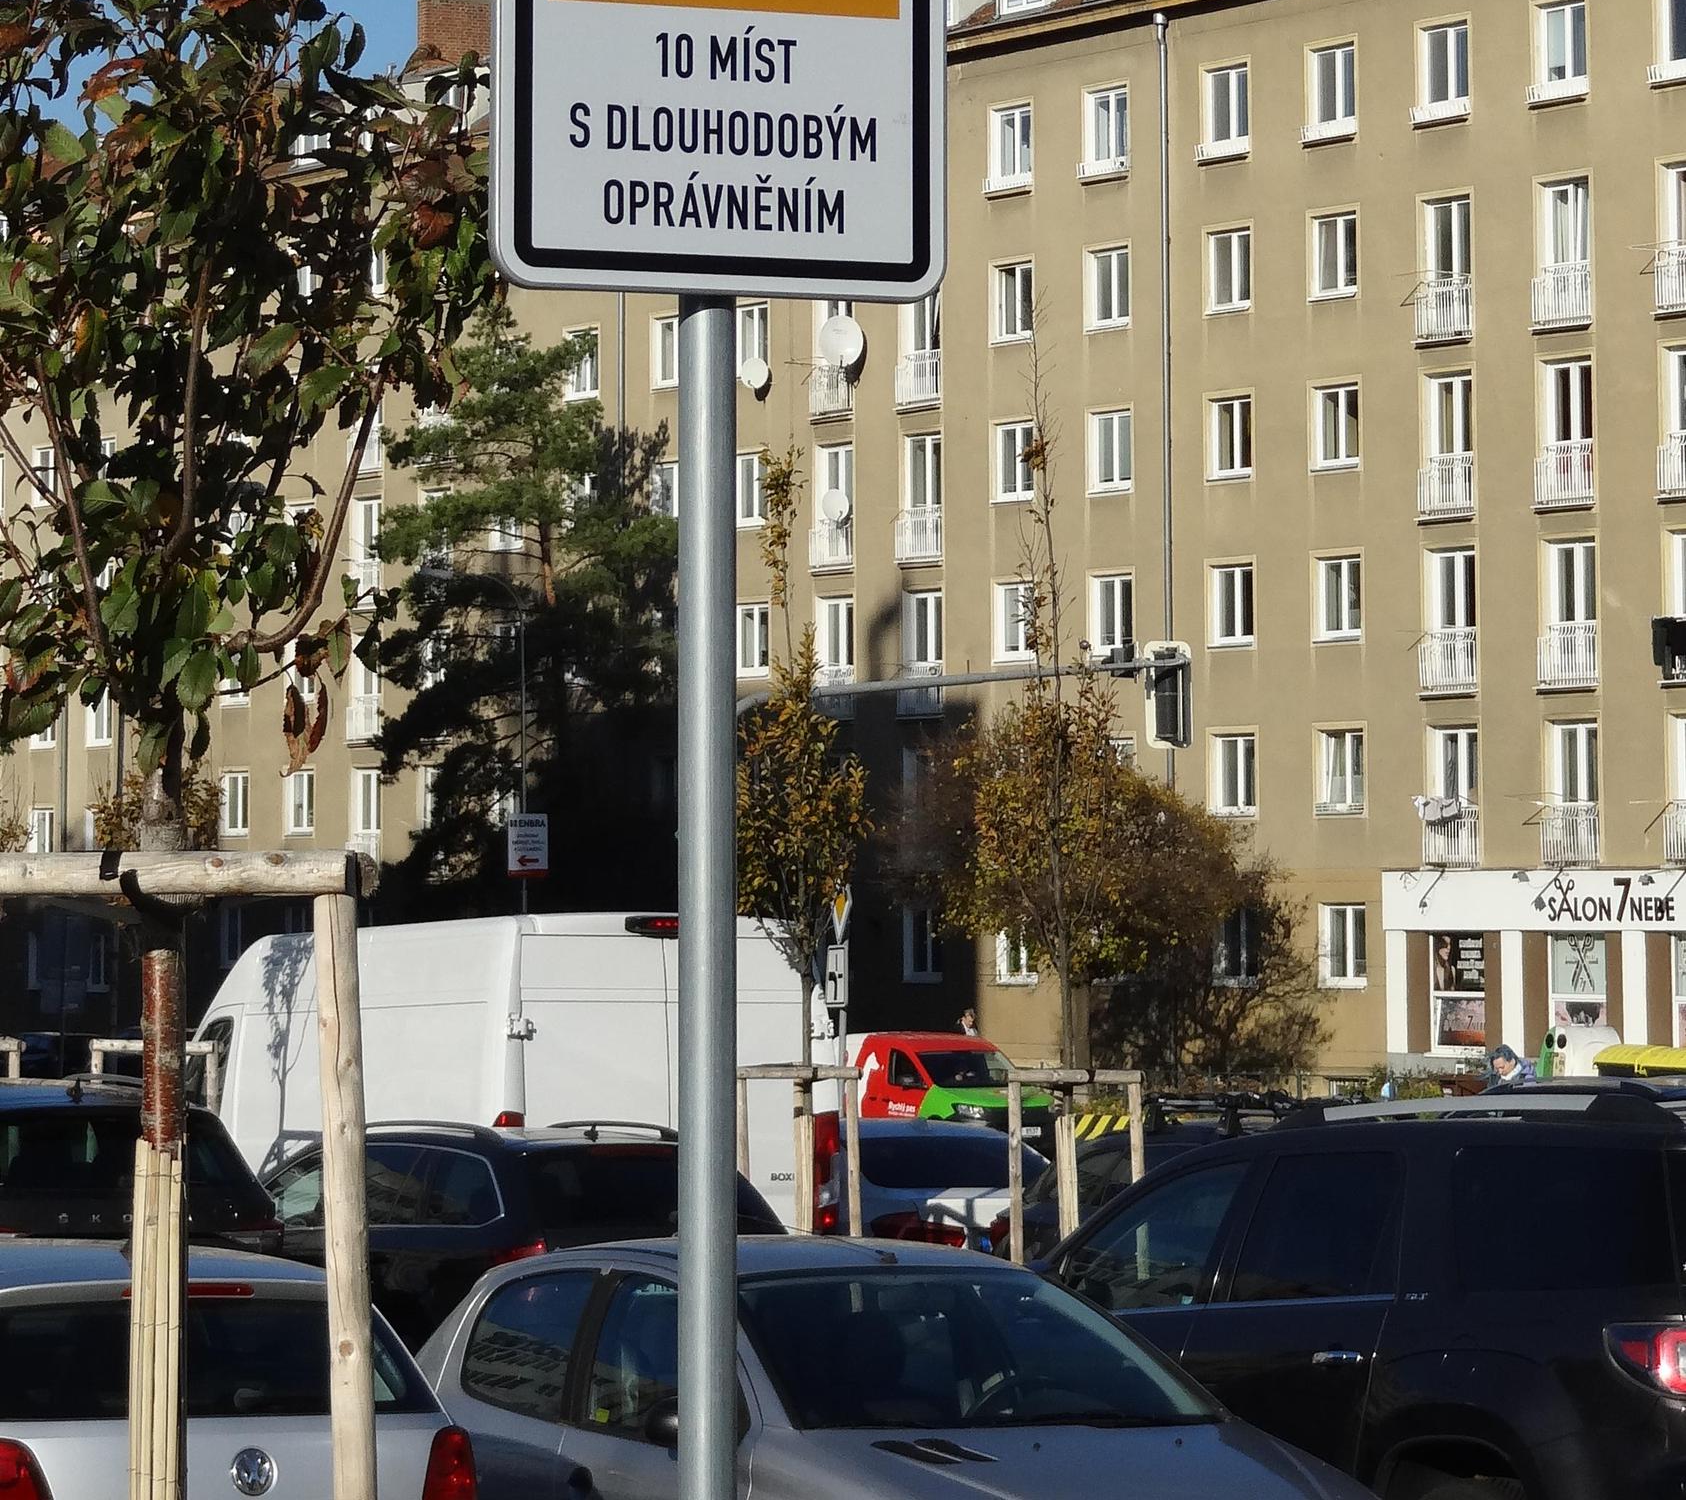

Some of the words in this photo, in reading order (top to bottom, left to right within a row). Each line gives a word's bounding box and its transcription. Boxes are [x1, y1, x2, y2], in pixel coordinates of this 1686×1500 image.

[655, 32, 694, 79] 10
[710, 25, 797, 84] MÍST
[569, 102, 591, 148] S
[607, 103, 877, 162] DLOUHODOBÝM
[603, 171, 845, 234] OPRÁVNĚNÍM
[1548, 879, 1611, 922] SALON
[1613, 877, 1632, 922] 7
[1630, 897, 1675, 921] NEBE
[770, 1172, 796, 1181] BOX
